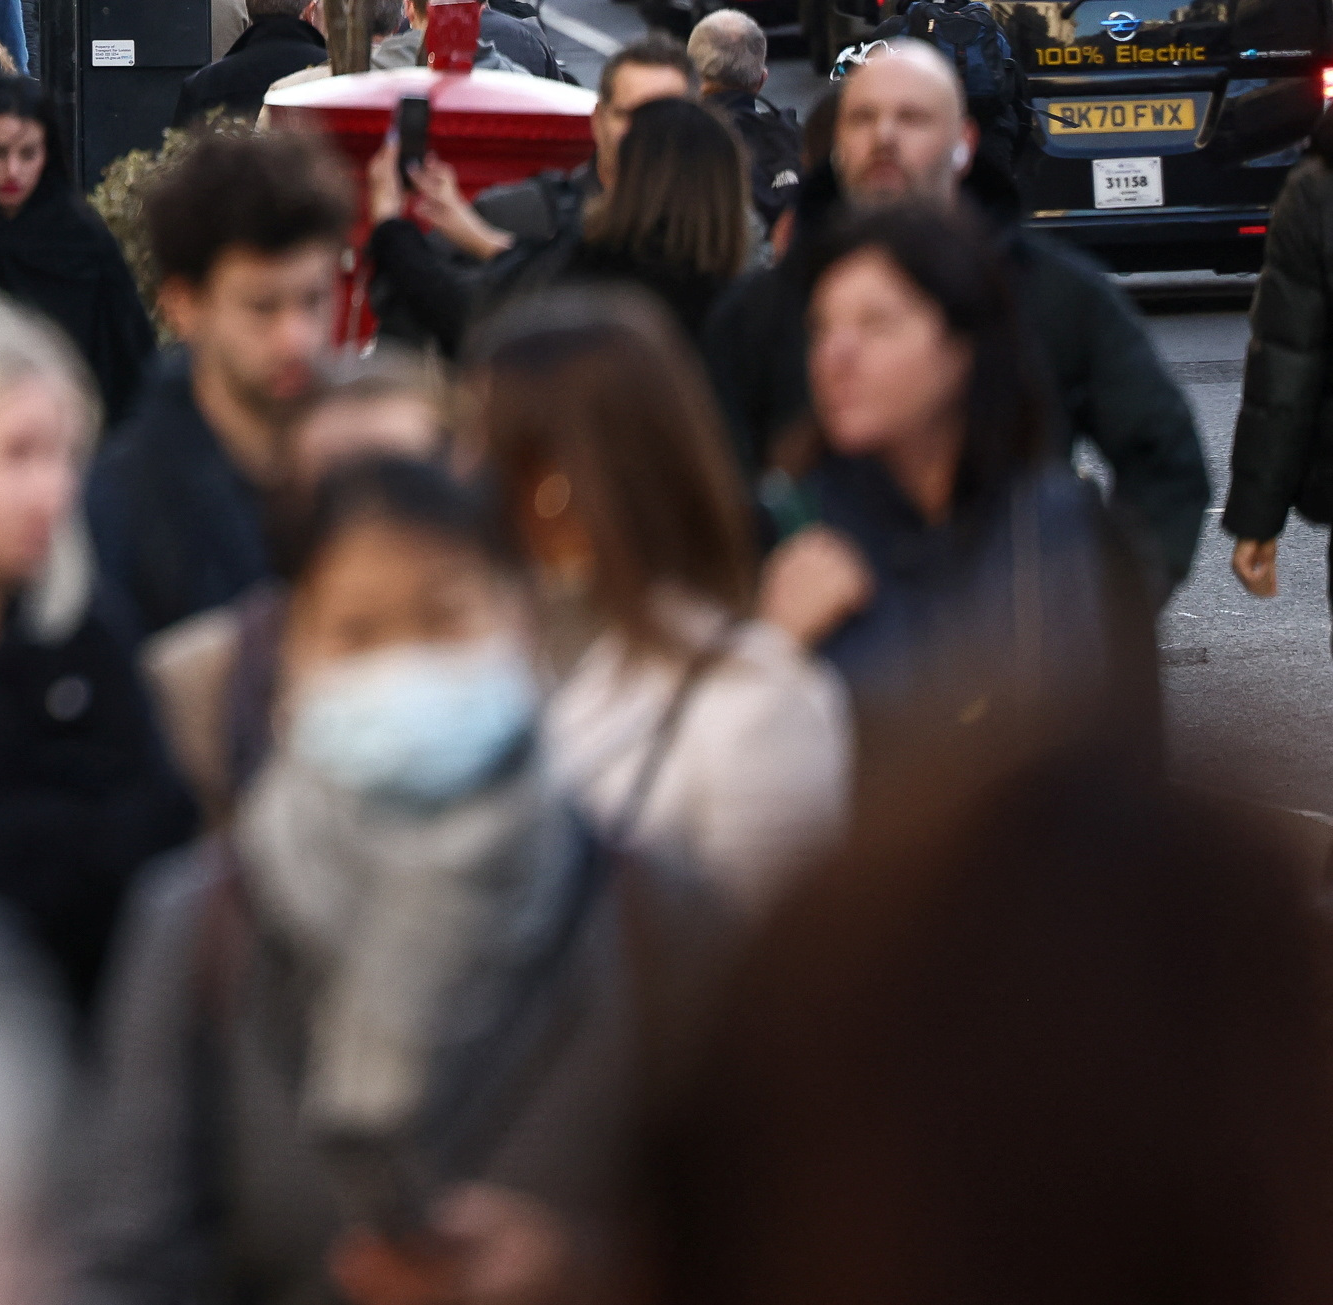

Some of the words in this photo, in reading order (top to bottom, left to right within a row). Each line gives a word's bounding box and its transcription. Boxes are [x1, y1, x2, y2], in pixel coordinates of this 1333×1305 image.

[1035, 46, 1105, 65] 100%
[1116, 43, 1206, 63] Electric
[1061, 106, 1126, 129] BK70
[1134, 104, 1182, 126] FWX
[1106, 176, 1148, 189] 31158
